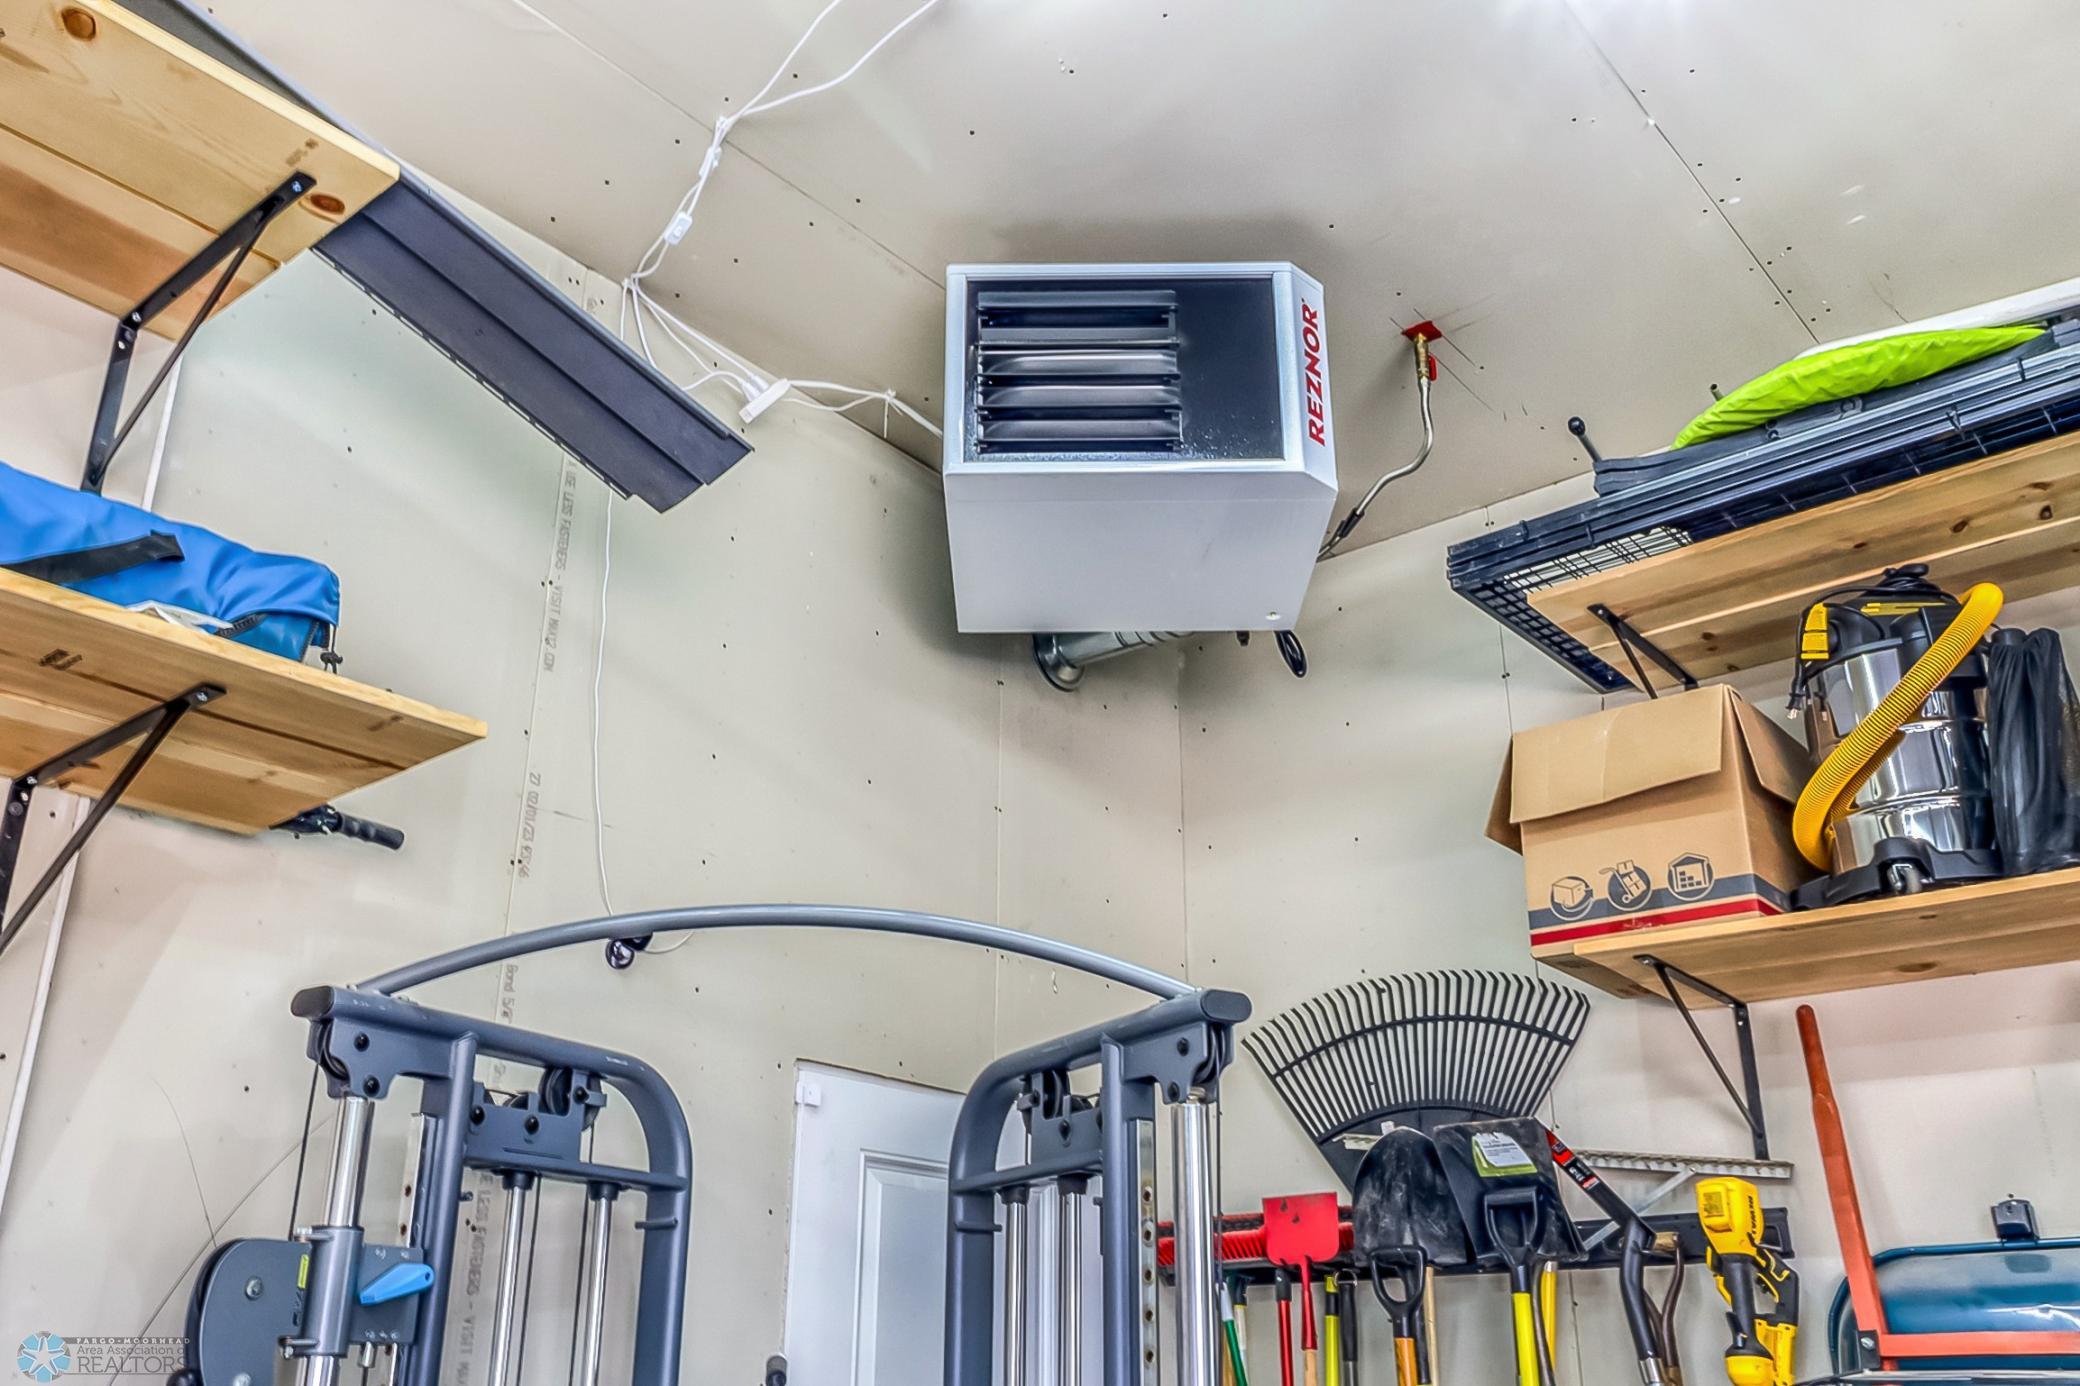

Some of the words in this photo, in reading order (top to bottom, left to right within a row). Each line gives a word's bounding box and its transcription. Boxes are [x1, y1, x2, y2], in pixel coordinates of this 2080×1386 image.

[1302, 303, 1326, 446] REZNOR
[565, 470, 577, 488] USE
[561, 491, 575, 517] LESS
[554, 519, 572, 571] FASTENERS
[550, 585, 562, 615] VISIT
[466, 1226, 488, 1296] FASTENERS
[460, 1315, 476, 1355] VISIT
